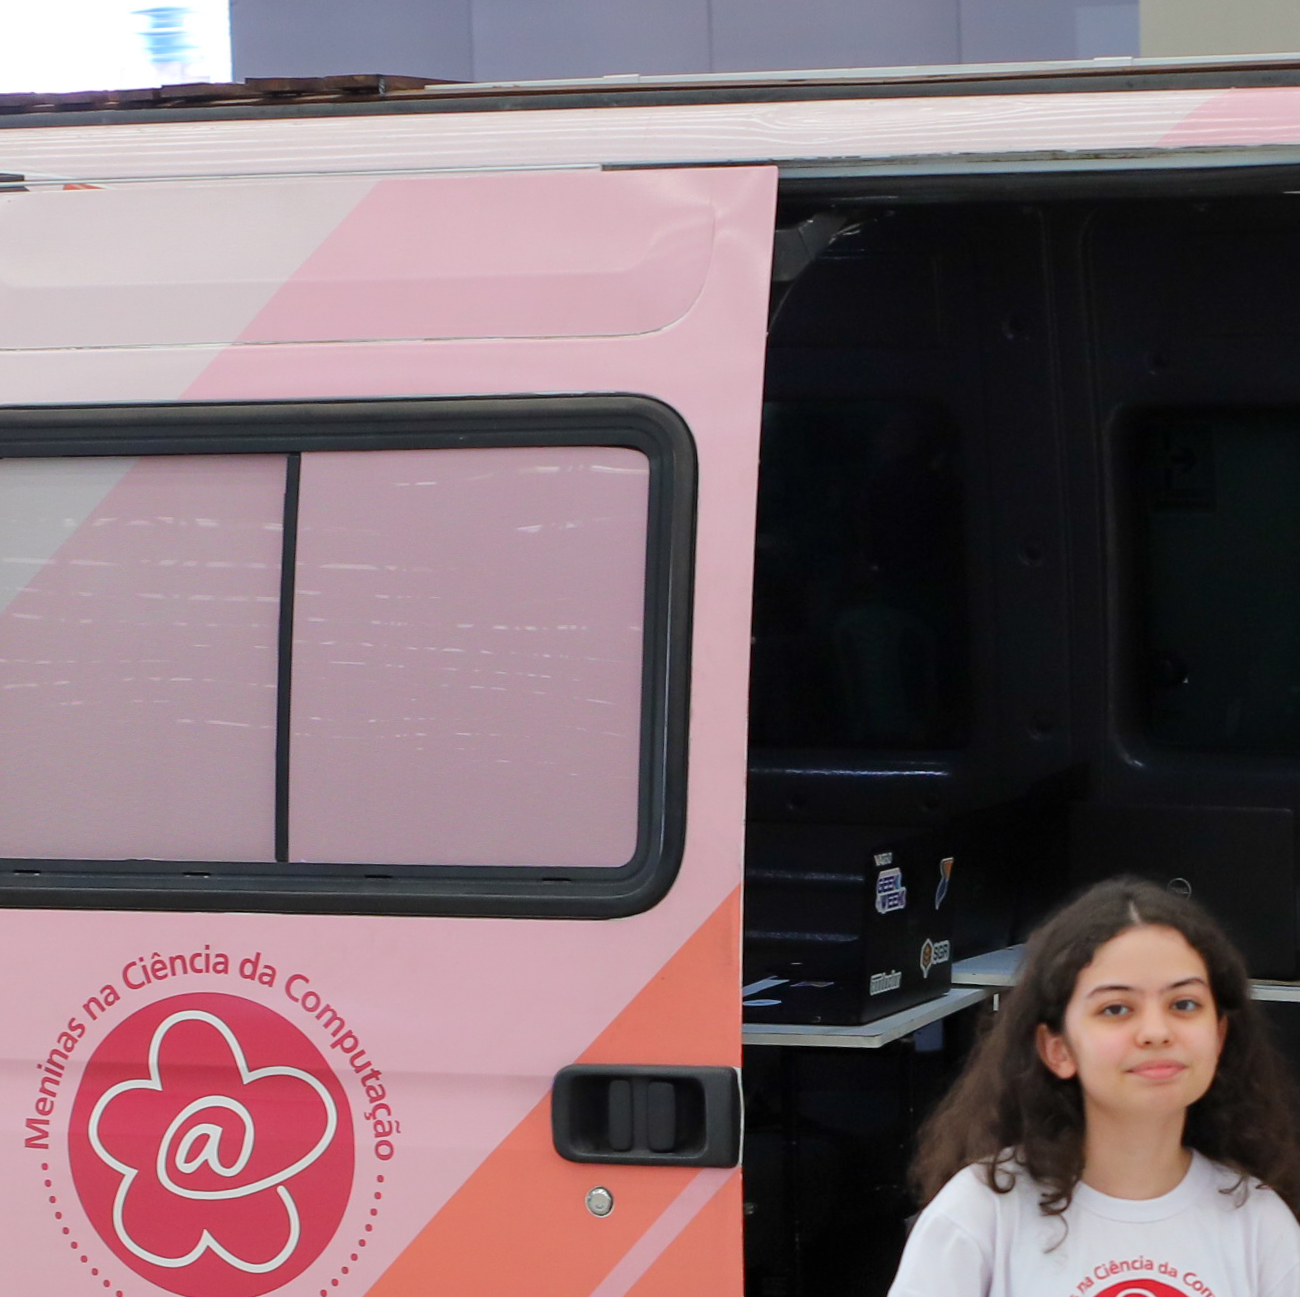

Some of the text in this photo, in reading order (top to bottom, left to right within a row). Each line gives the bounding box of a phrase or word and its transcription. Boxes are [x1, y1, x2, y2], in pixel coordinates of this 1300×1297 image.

[24, 944, 401, 1162] Meninas na Ciência da Computação
[1077, 1276, 1095, 1293] na
[1094, 1255, 1154, 1281] Ciência
[1158, 1262, 1178, 1278] da
